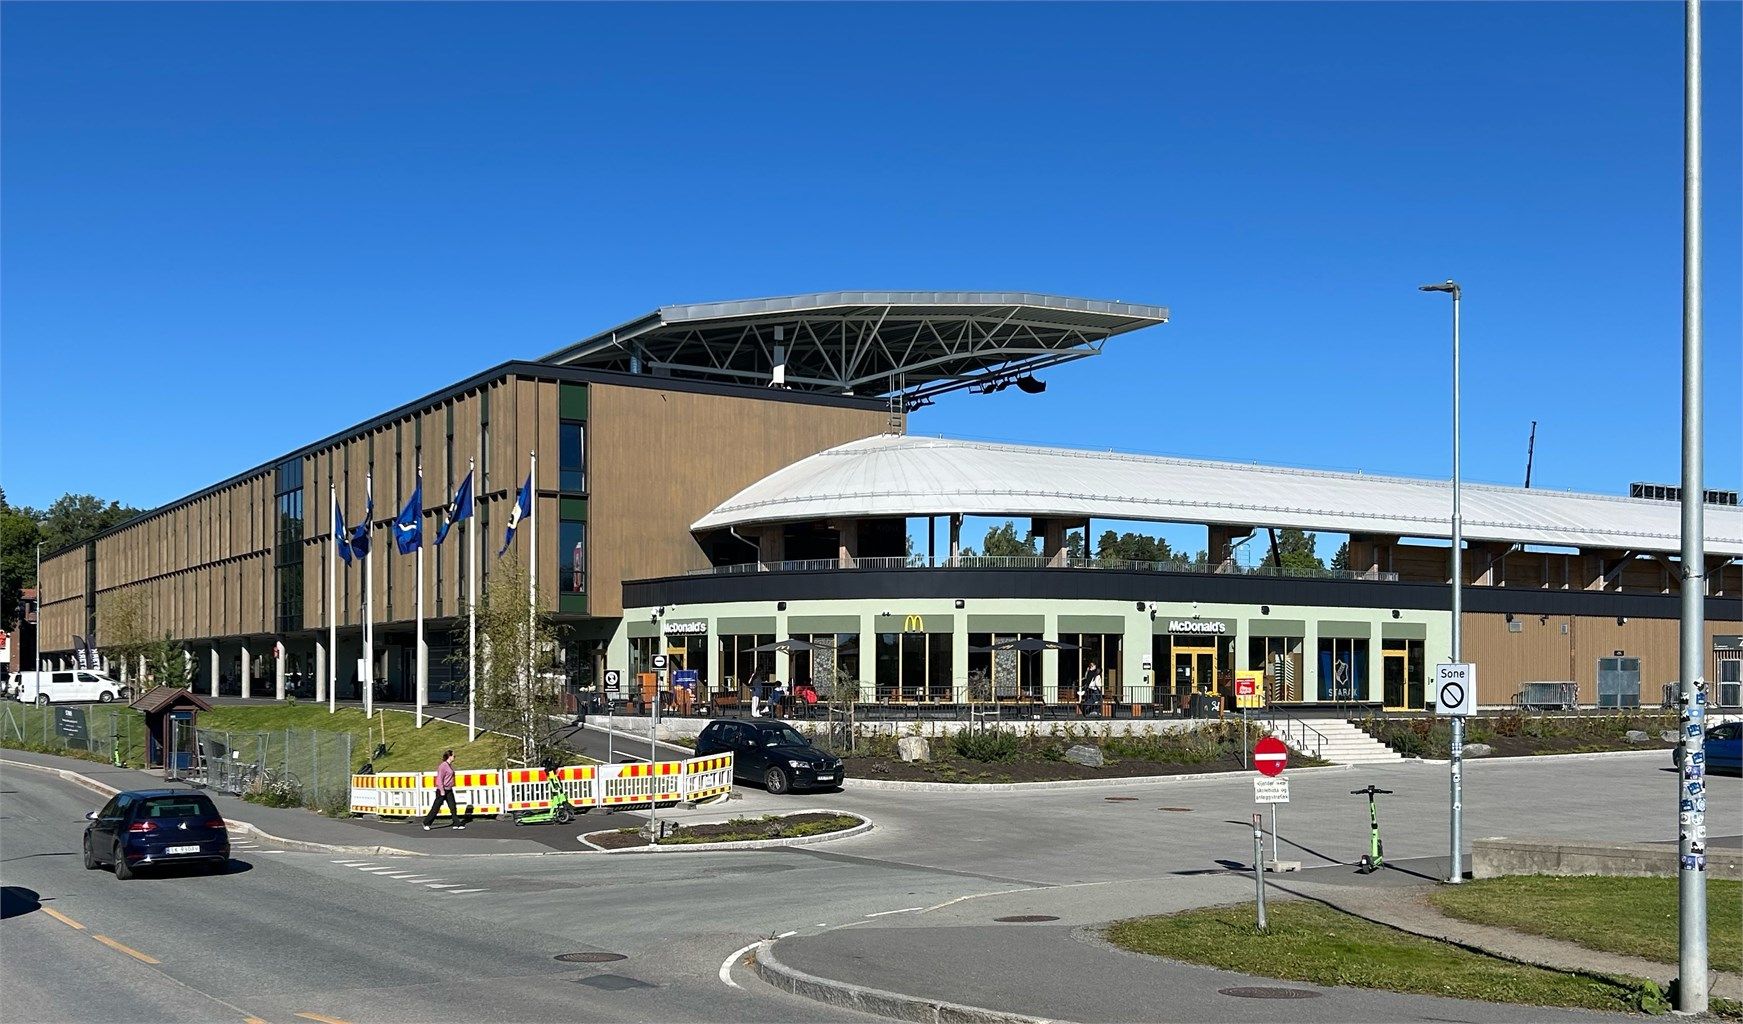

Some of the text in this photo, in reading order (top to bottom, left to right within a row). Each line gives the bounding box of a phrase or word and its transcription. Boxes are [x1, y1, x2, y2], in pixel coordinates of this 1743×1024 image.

[664, 622, 707, 633] McDonald's
[1168, 620, 1226, 632] McDonald's
[1441, 668, 1465, 679] Sone
